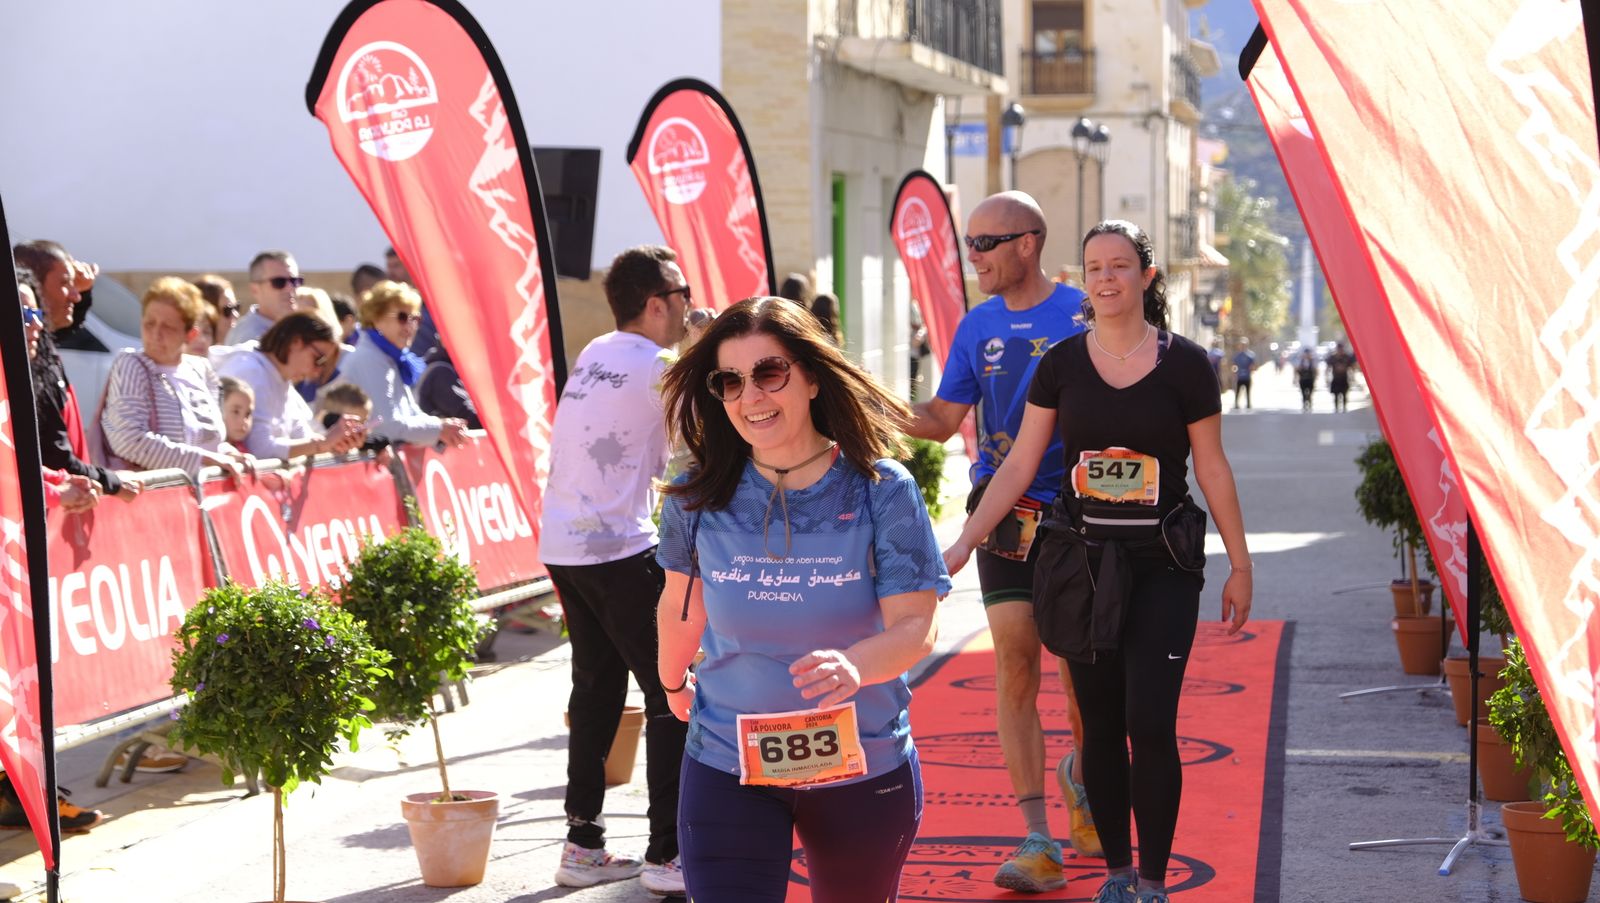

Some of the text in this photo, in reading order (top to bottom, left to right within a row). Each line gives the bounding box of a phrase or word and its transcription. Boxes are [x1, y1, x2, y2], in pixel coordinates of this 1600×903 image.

[1088, 461, 1141, 479] 547
[457, 482, 533, 546] VEOL
[747, 591, 804, 602] PURCHENA
[804, 714, 832, 723] CANTORIA
[760, 723, 792, 732] PÓLVORA
[760, 730, 839, 763] 683
